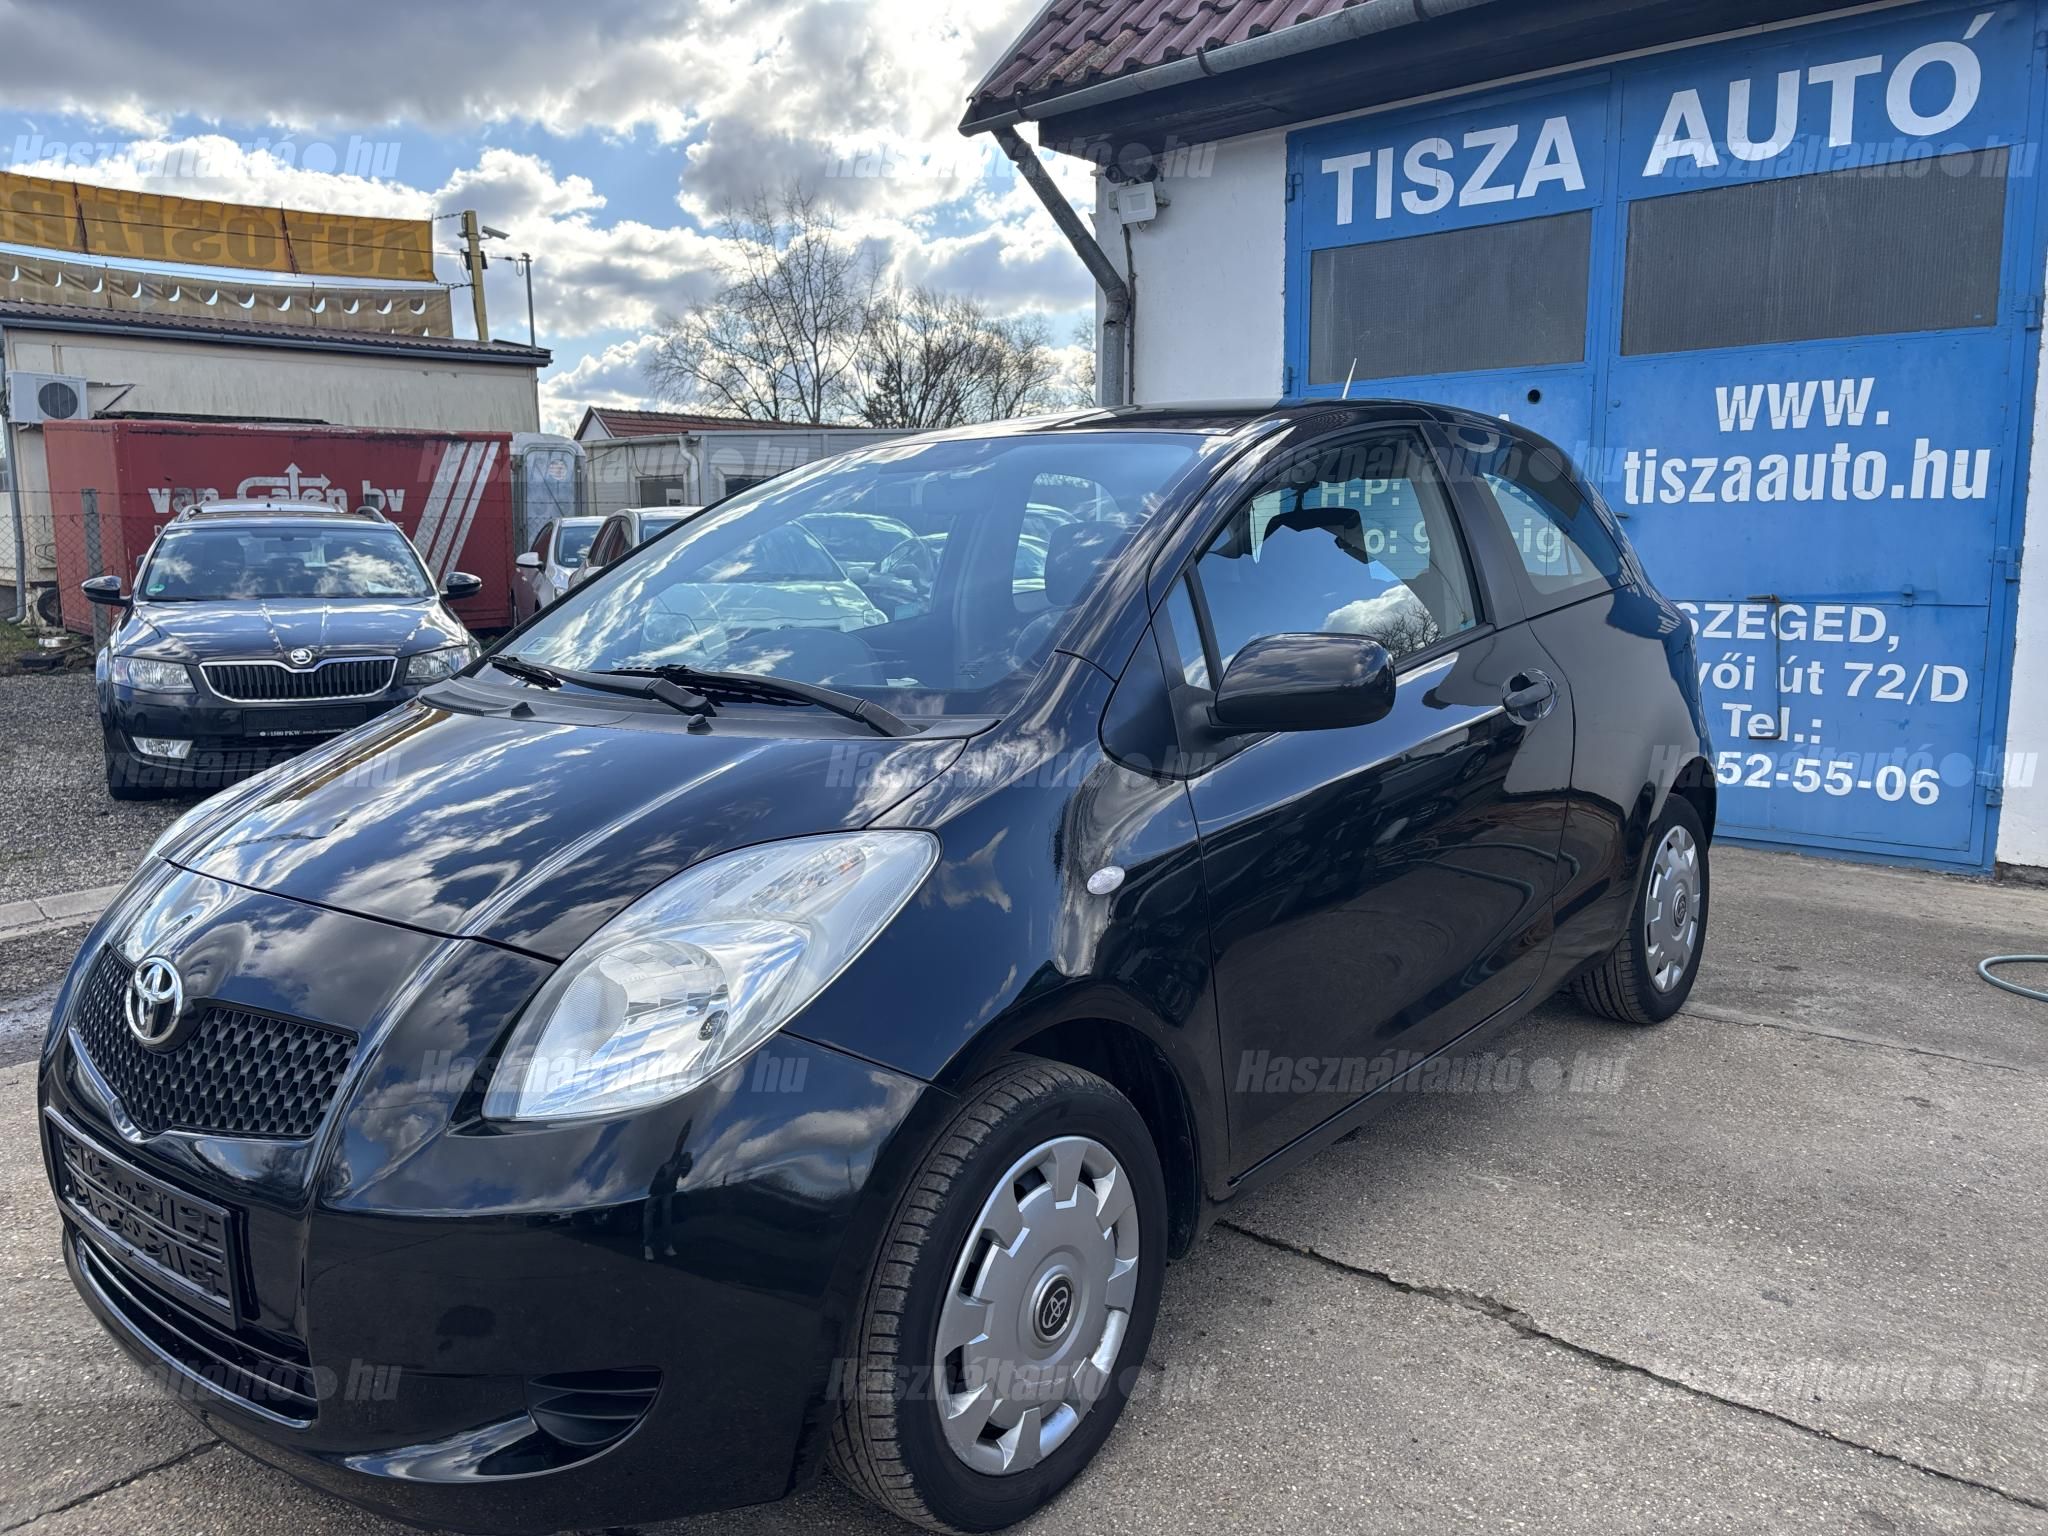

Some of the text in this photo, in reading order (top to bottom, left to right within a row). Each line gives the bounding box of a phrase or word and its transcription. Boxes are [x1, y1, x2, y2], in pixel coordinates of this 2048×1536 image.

[1321, 11, 1996, 227] TISZA AUTÓ
[1715, 377, 1890, 432] www.
[362, 480, 405, 512] bv
[1624, 438, 1991, 505] tiszaauto.hu
[1675, 602, 1900, 653] SZEGED,
[1775, 655, 1825, 695] út
[1844, 661, 1969, 705] 72/D
[1722, 703, 1822, 744] Tel.:
[1716, 751, 1940, 806] 52-55-06
